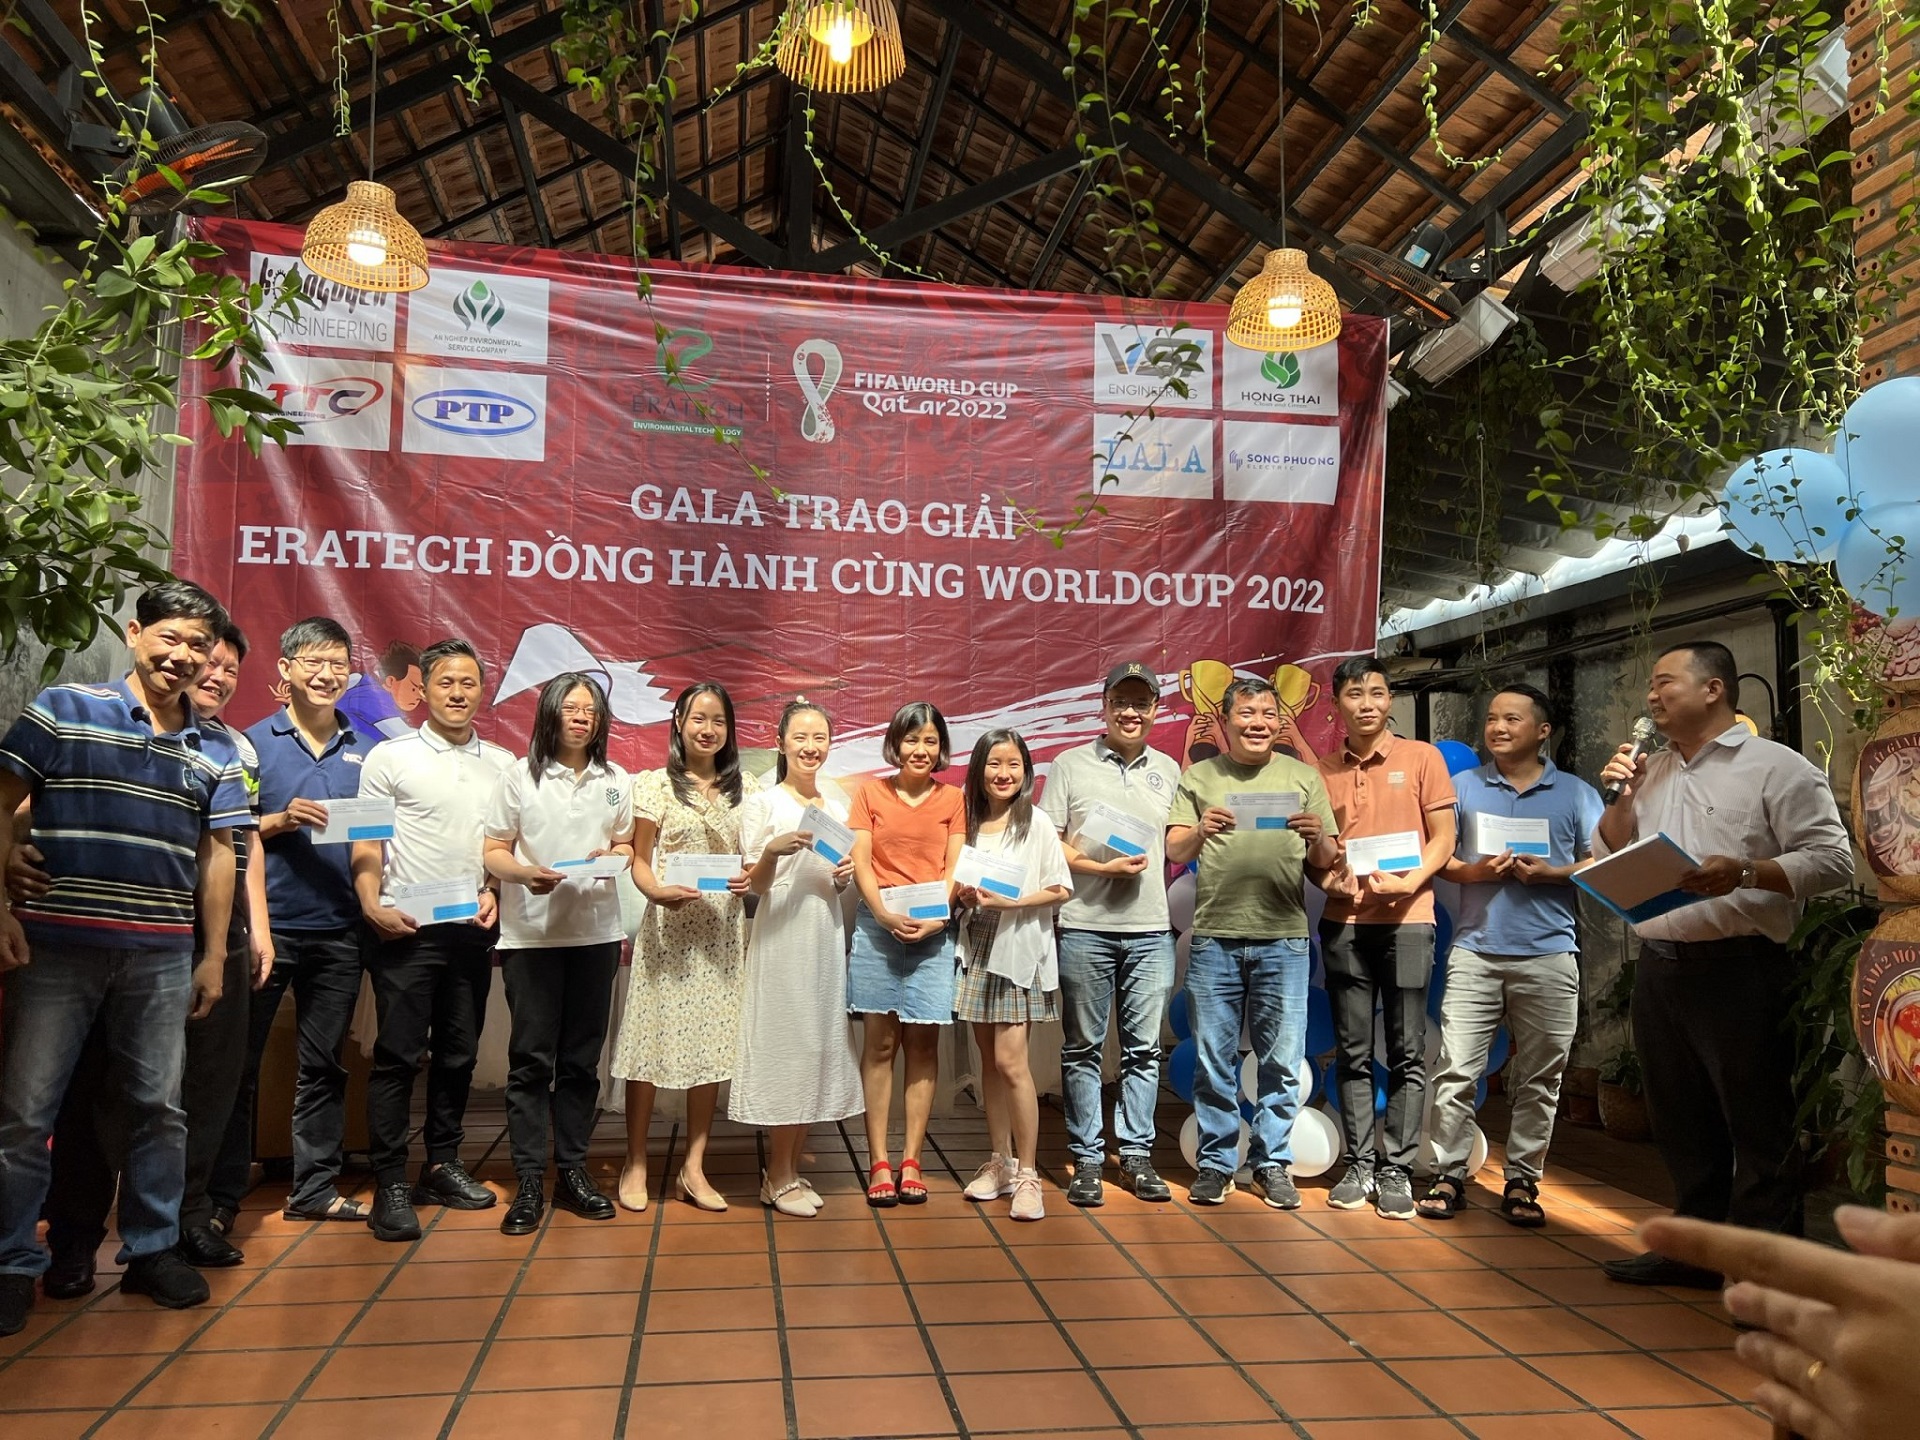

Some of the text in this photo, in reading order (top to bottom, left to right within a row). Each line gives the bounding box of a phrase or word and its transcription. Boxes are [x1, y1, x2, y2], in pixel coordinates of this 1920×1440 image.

[448, 343, 508, 355] SERVICE COMPANY
[469, 337, 522, 347] ENVIRONMENTAL
[854, 371, 1018, 398] FIFA WORLD CUP
[1108, 383, 1198, 400] ENGINEERIG
[267, 383, 366, 415] TTC
[1241, 391, 1320, 405] HONG THAI
[434, 399, 515, 424] PTP
[633, 421, 742, 437] ENVIRONMENTAL TECHNLOGY
[1247, 454, 1335, 466] SONG PHUONG
[630, 482, 1018, 540] GALA TRAO GIẢI
[237, 524, 1325, 614] ERATECH ĐỒNG HÀNH CÙNG WORLDCUP 2022
[1880, 955, 1892, 970] 2
